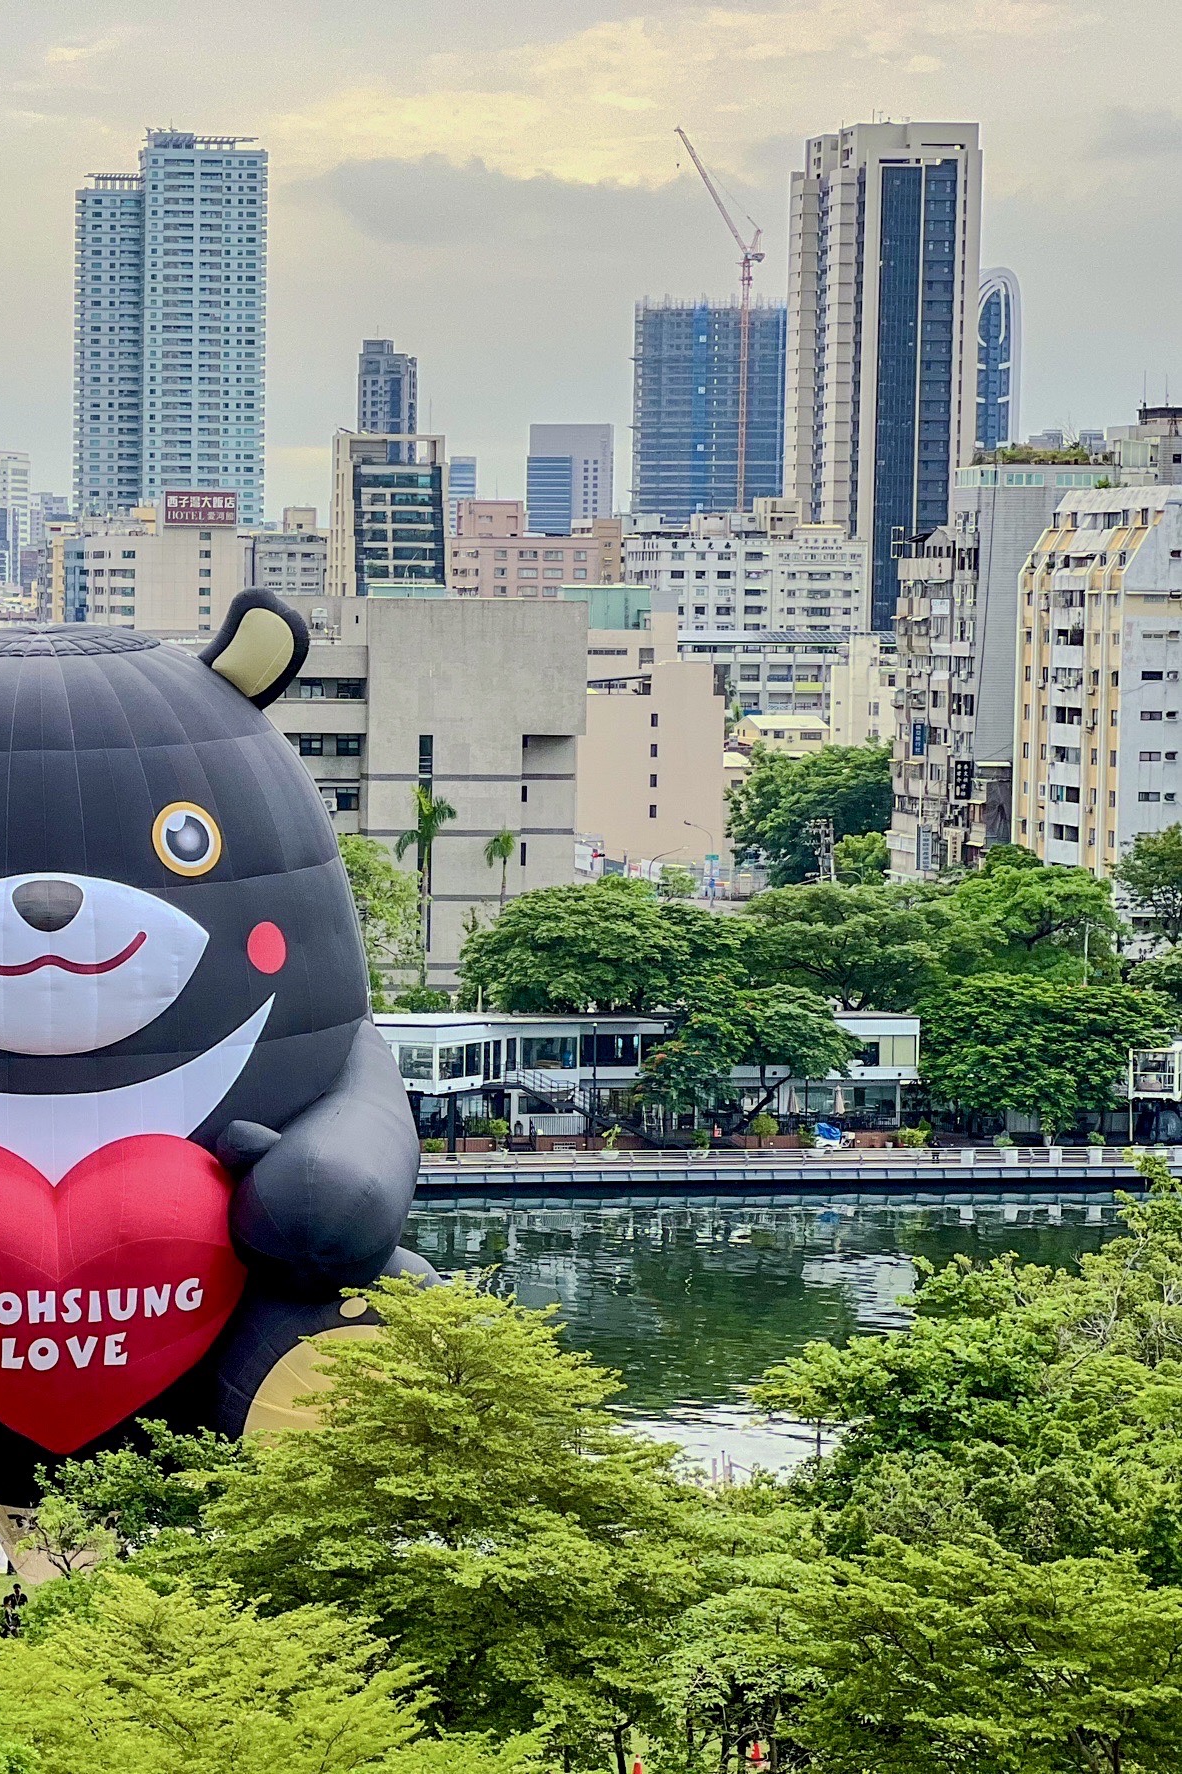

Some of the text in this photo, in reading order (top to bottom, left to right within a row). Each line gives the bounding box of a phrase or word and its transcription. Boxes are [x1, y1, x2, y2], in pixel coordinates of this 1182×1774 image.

[167, 495, 235, 508] 西子灣大飯店
[167, 511, 205, 520] HOTEL
[1, 1332, 128, 1371] LOVE
